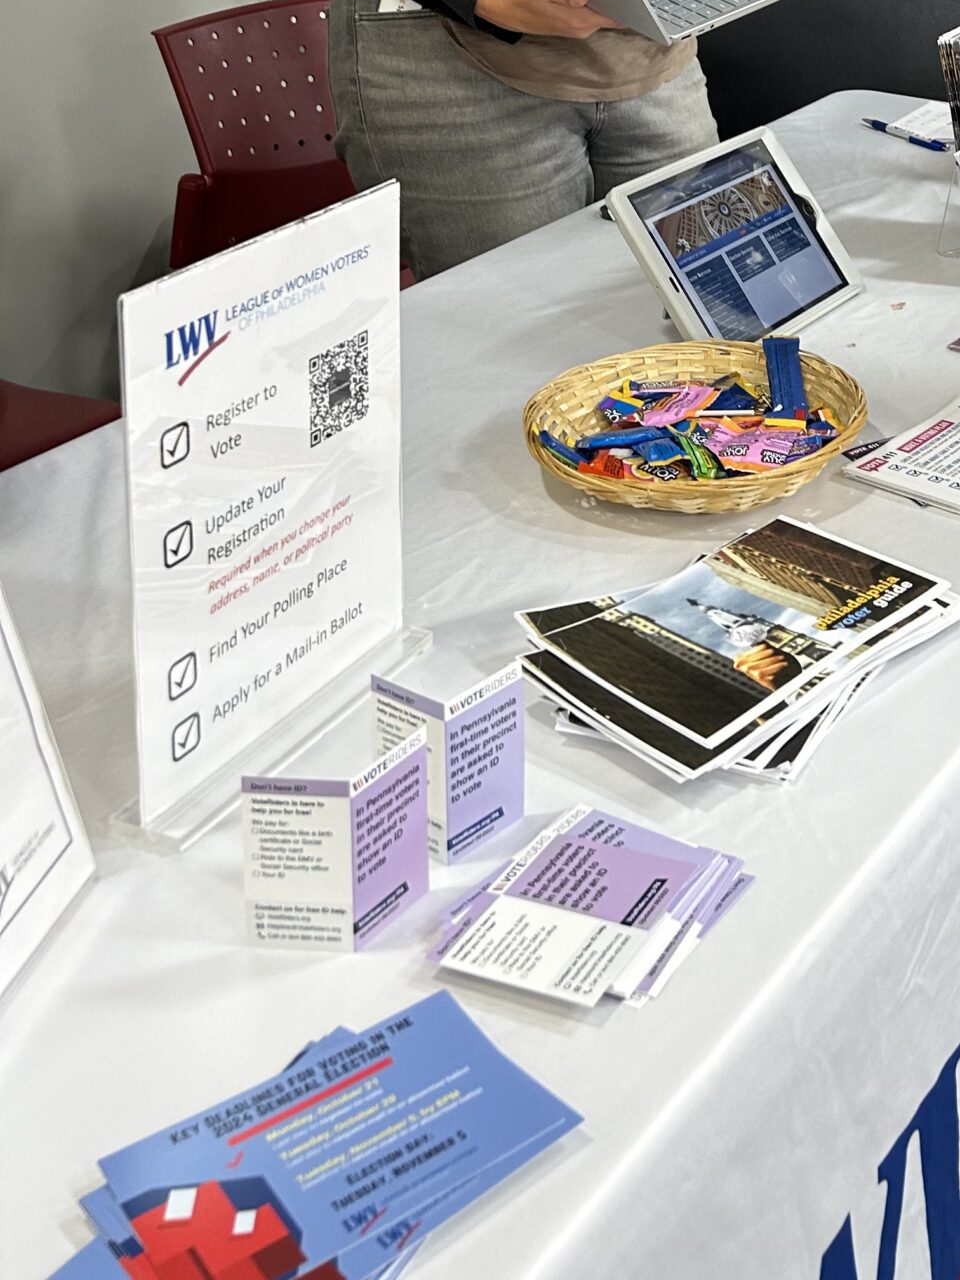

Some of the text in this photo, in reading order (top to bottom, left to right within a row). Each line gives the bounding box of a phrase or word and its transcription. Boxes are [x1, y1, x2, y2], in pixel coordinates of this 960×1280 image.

[225, 290, 269, 321] LEAGUE
[285, 264, 328, 291] WOMEN
[237, 281, 325, 331] OF PHILADELPHIA
[163, 310, 219, 370] LWV
[206, 384, 277, 431] Register to
[210, 433, 241, 458] Vote
[849, 447, 867, 456] VOTE
[860, 451, 898, 471] VOTE 411
[205, 476, 285, 534] Update Your
[207, 508, 284, 563] Registration
[208, 494, 351, 593] Required when you change your
[209, 583, 249, 614] address,
[283, 551, 293, 565] or
[294, 525, 329, 560] political
[330, 513, 353, 536] party
[209, 559, 347, 662] Find Your Polling Place
[814, 574, 900, 631] philadelphia
[833, 581, 913, 630] voter guide
[212, 602, 362, 722] Apply for a Mail-in Ballot
[460, 669, 518, 709] VOTERIDERS
[449, 710, 516, 753] first-time voters
[460, 697, 516, 734] Pennsylvania
[363, 734, 422, 785] VOTERIDERS
[450, 721, 516, 766] in their precinct
[450, 742, 504, 778] are asked to
[366, 764, 419, 809] Pennsylvania
[450, 756, 499, 791] show an ID
[450, 780, 481, 803] to vote
[356, 777, 419, 830] first-time voters
[356, 789, 419, 844] in their precinct
[356, 813, 407, 857] are asked to
[357, 828, 403, 870] show an ID
[503, 834, 552, 884] VOTERIDERS
[357, 856, 386, 883] to vote
[169, 1017, 412, 1144] KEY DEADLINES FOR VOTING IN THE
[213, 1042, 389, 1137] 2024 GENERAL ELECTION
[346, 1149, 403, 1185] ELECTION
[392, 1137, 454, 1176] NOVEMBER
[456, 1130, 467, 1140] 5
